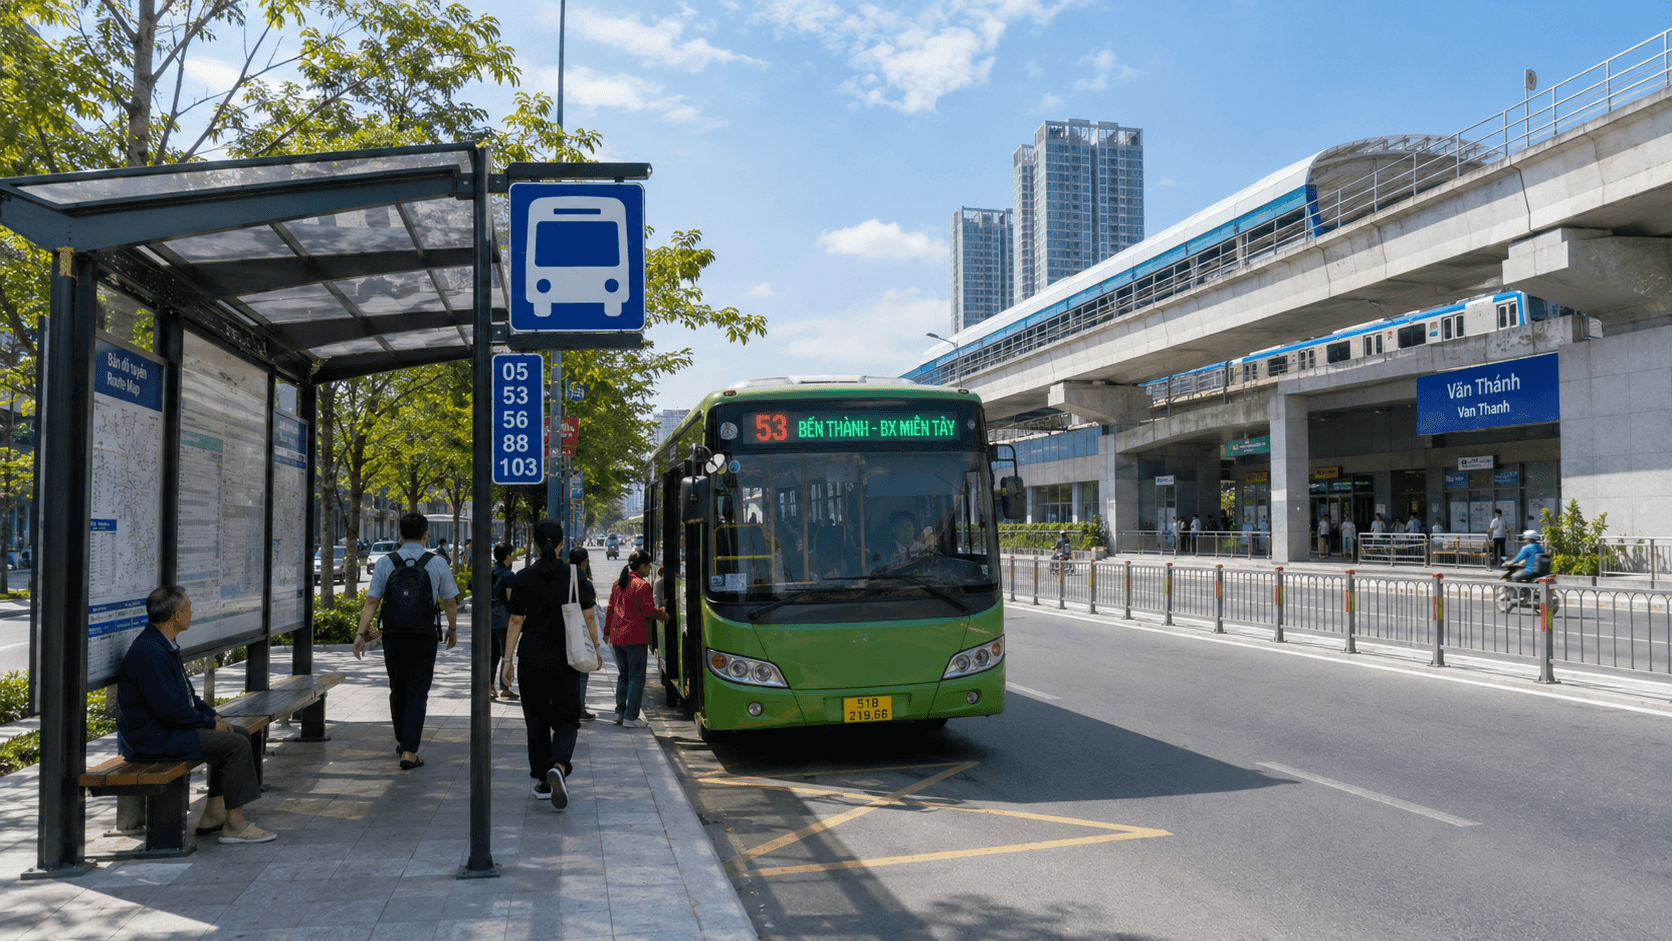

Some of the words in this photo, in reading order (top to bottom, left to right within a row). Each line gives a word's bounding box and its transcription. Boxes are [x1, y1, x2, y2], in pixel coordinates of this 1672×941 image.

[502, 362, 528, 381] 05
[107, 371, 127, 390] Route
[126, 378, 140, 398] Map
[1447, 381, 1472, 399] Văn
[1475, 372, 1521, 395] Thánh
[502, 386, 528, 405] 53
[1457, 405, 1476, 418] Van
[1477, 399, 1510, 416] Thanh
[502, 410, 528, 429] 56
[755, 413, 788, 441] 53
[825, 416, 869, 437] THÀNH
[880, 420, 897, 437] BX
[502, 434, 528, 453] 88
[499, 457, 537, 477] 103
[849, 709, 888, 721] 219.66
